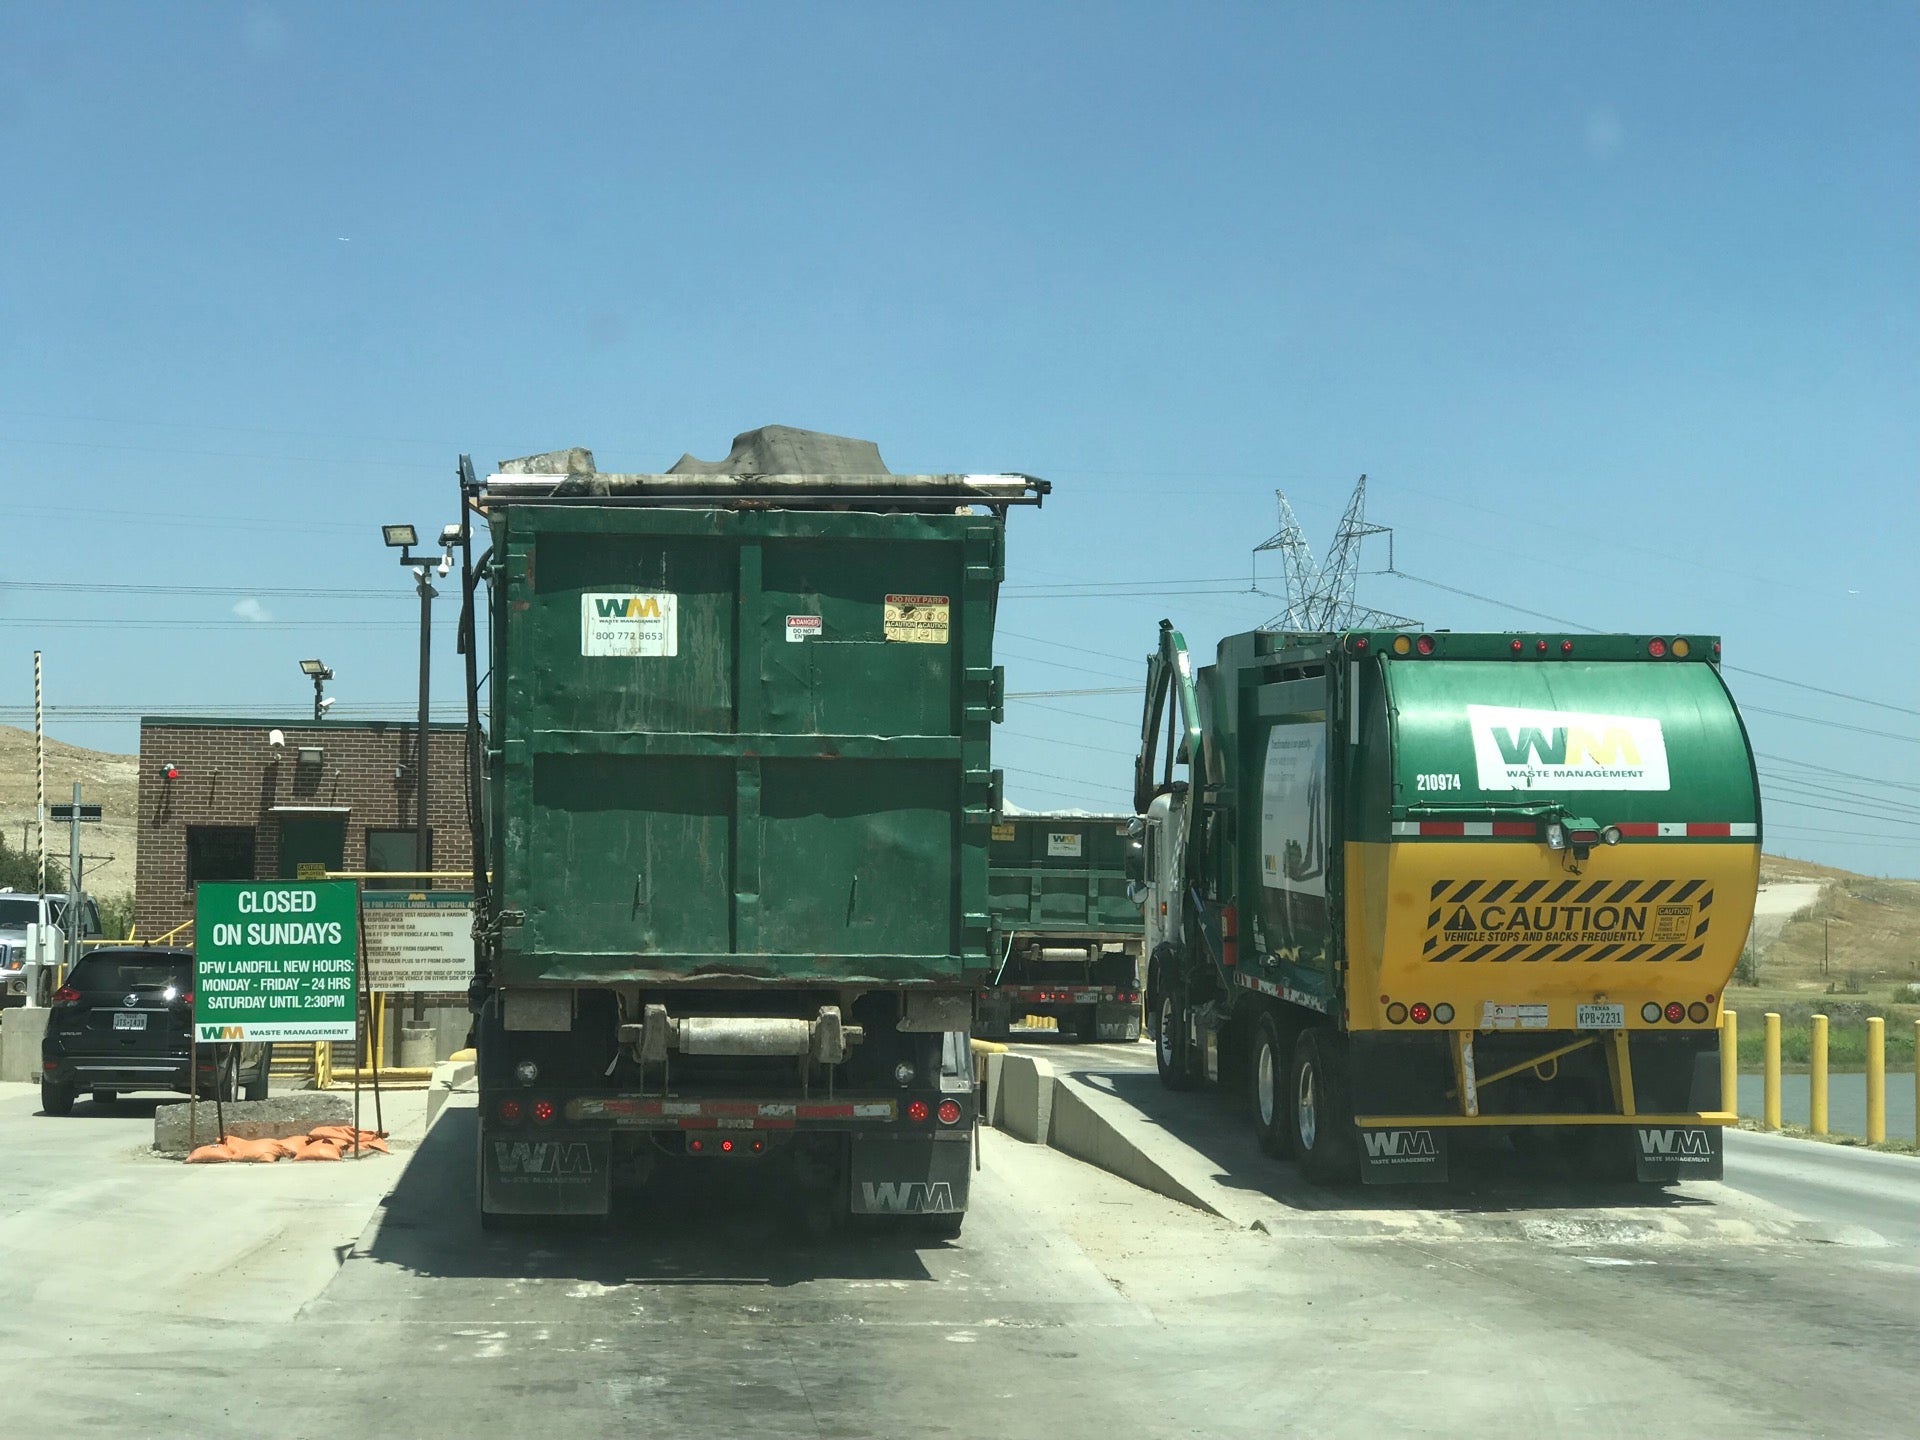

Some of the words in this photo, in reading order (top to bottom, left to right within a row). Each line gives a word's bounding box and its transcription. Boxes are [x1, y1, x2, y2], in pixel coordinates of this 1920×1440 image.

[595, 598, 660, 617] WM
[596, 632, 615, 640] 800
[617, 632, 636, 640] 772
[638, 632, 663, 641] 8653
[1490, 727, 1642, 765] WM
[1417, 773, 1461, 791] 210974
[1506, 770, 1550, 778] WASTE
[1553, 770, 1644, 778] MANAGEMENT
[238, 890, 317, 914] CLOSED
[1480, 906, 1648, 931] CAUTION
[212, 923, 242, 946] ON
[247, 922, 342, 946] SUNDAYS
[1444, 931, 1486, 942] VEHICLE
[1487, 931, 1520, 942] STOPS
[1522, 931, 1543, 942] AND
[1545, 931, 1579, 942] BACKS
[1581, 931, 1645, 943] FREQUENTLY
[199, 961, 226, 974] DFW
[228, 960, 281, 974] LANDFILL
[283, 960, 310, 973] NEW
[312, 959, 355, 973] HOURS:
[202, 978, 251, 992] MONDAY
[260, 977, 300, 991] FRIDAY
[311, 977, 325, 990] 24
[328, 977, 351, 990] HRS
[207, 996, 267, 1009] SATURDAY
[269, 995, 302, 1008] UNTIL
[304, 995, 345, 1008] 2:30PM
[200, 1026, 244, 1039] WM
[1363, 1130, 1435, 1156] WM
[1639, 1129, 1710, 1154] WM
[494, 1142, 592, 1173] WM
[862, 1182, 954, 1211] WM
